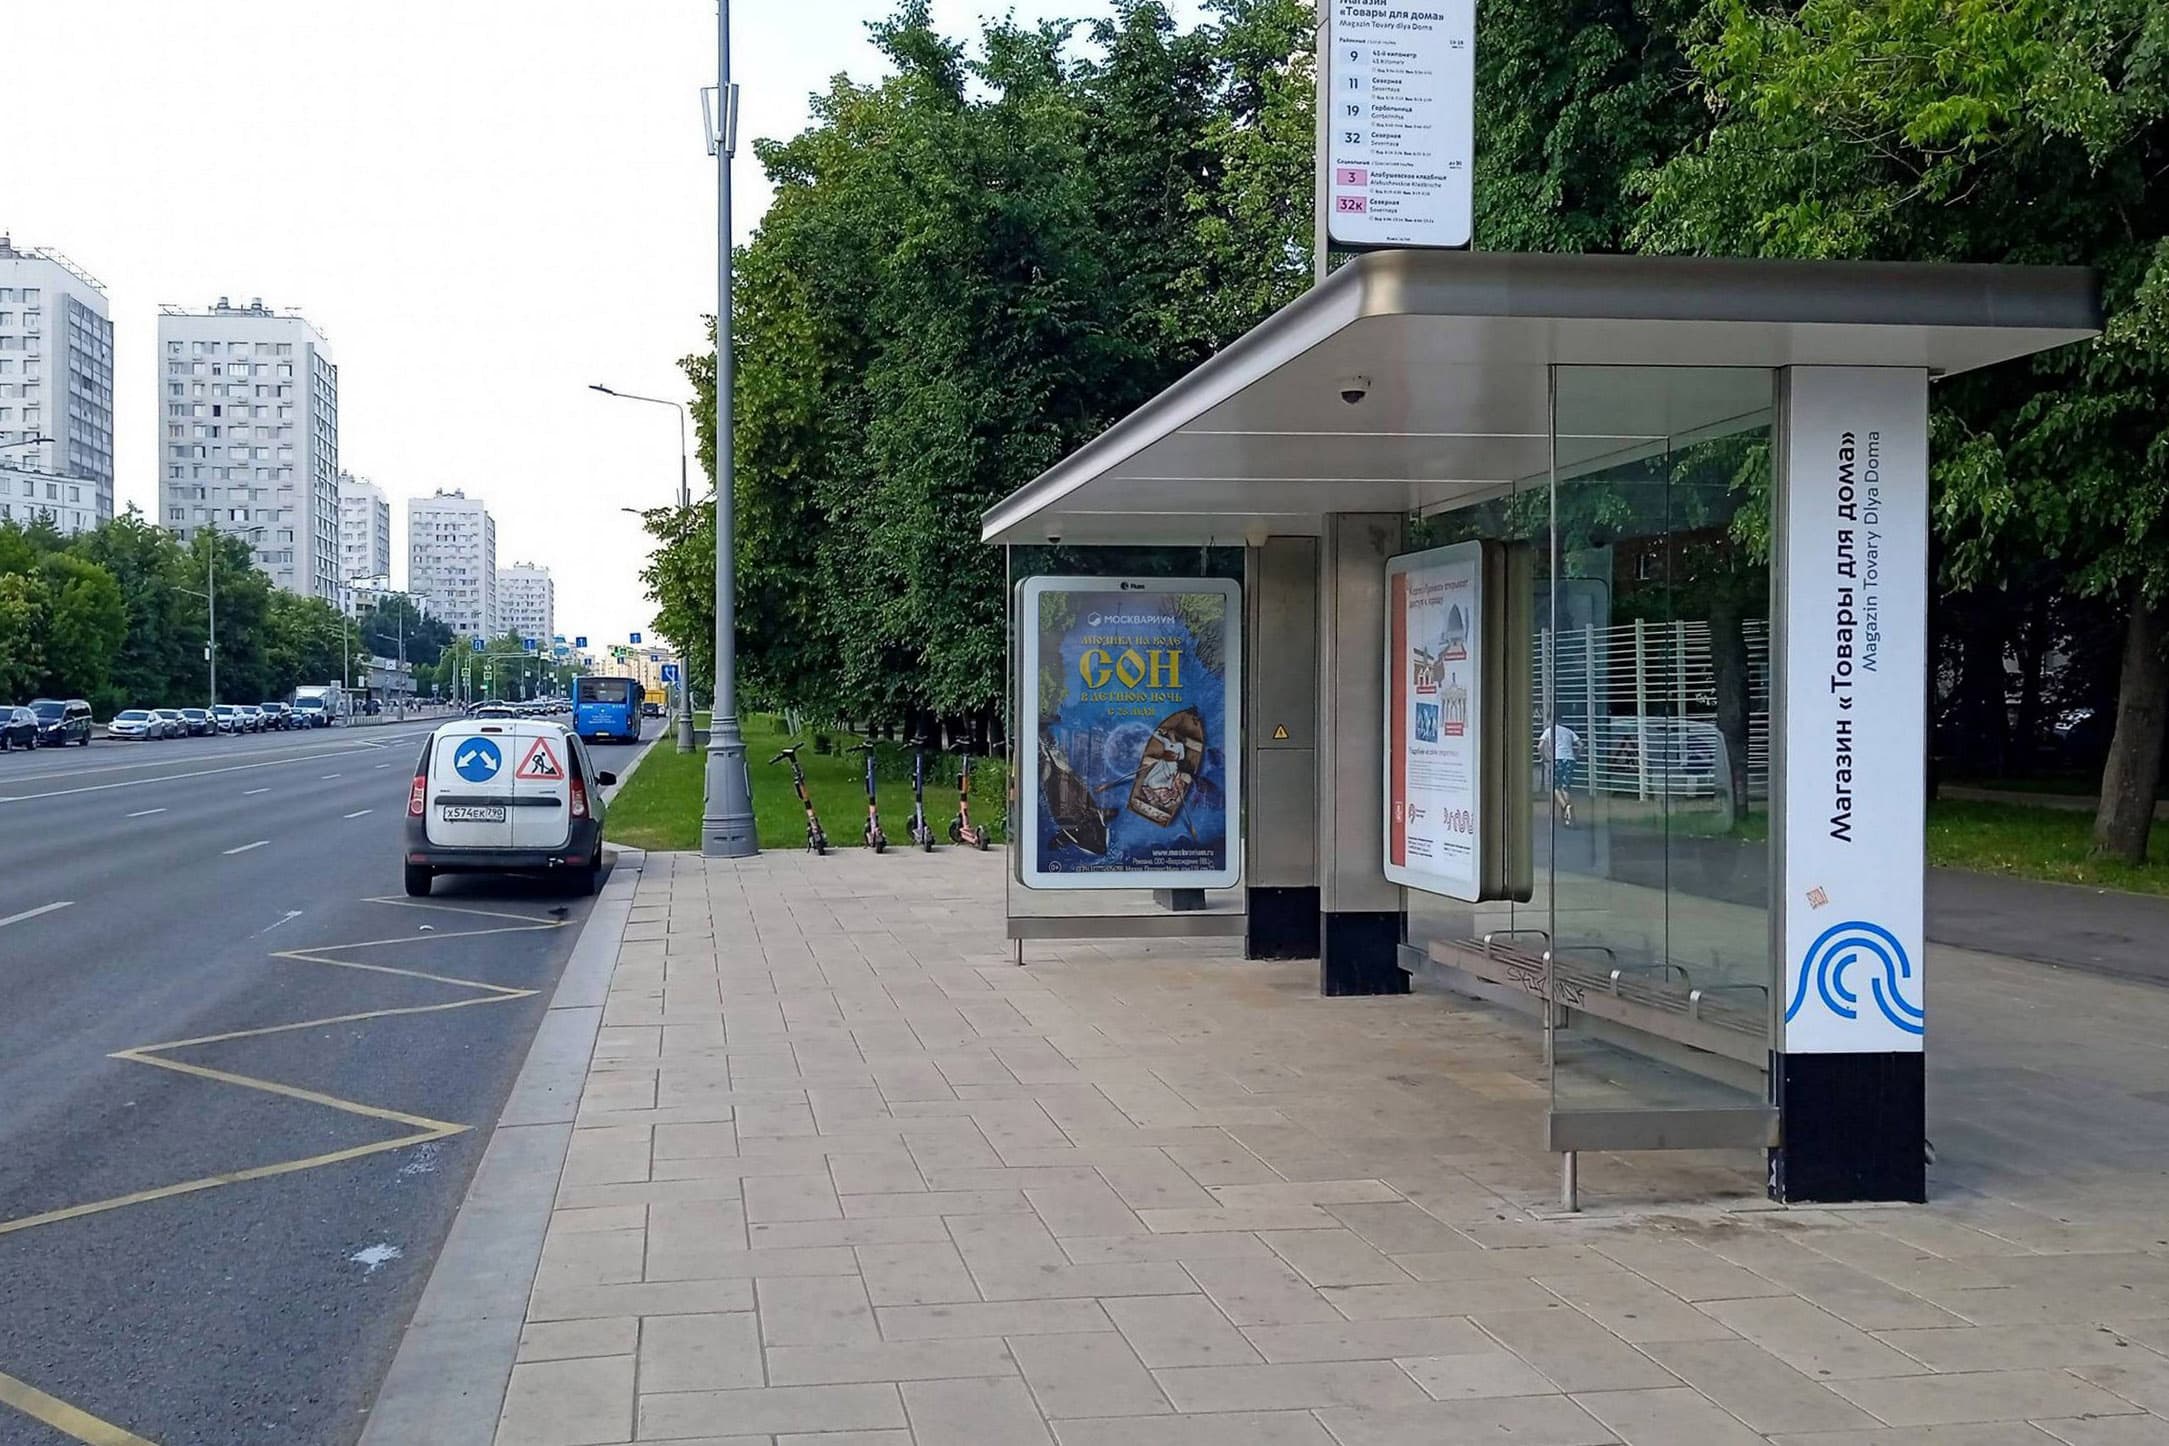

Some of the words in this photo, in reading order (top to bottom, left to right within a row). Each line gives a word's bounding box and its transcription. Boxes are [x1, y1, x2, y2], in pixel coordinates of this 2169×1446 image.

[1340, 6, 1387, 19] «Товары
[1389, 10, 1409, 19] для
[1411, 12, 1444, 20] дома»
[1350, 50, 1358, 62] 9
[1348, 78, 1358, 89] 11
[1347, 105, 1360, 117] 19
[1345, 132, 1361, 144] 32
[1348, 172, 1356, 183] 3
[1838, 431, 1857, 521] дома»
[1864, 430, 1880, 483] Doma
[1864, 487, 1882, 526] Dlya
[1837, 528, 1857, 580] для
[1863, 530, 1882, 591] Tovary
[1104, 615, 1175, 625] МОСКВАРИУМ
[1863, 595, 1880, 673] Magazin
[1080, 649, 1183, 689] СОН
[1829, 719, 1853, 843] Магазин
